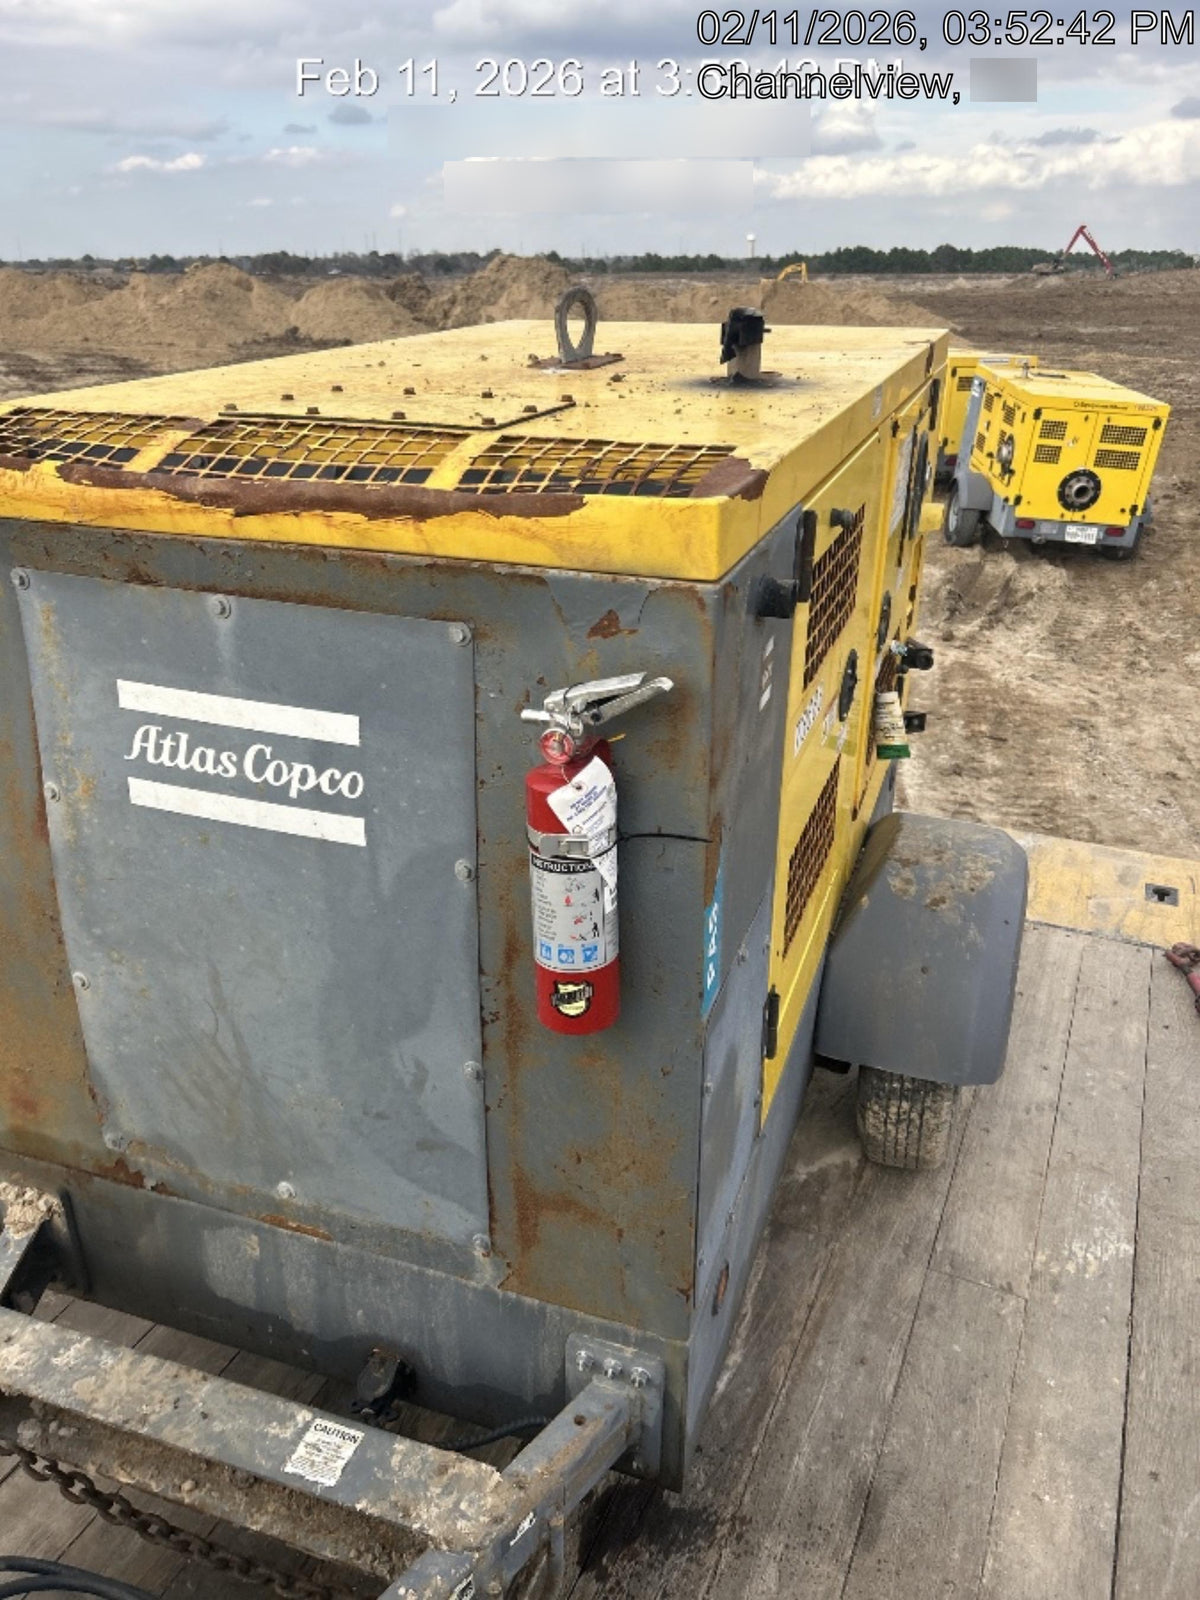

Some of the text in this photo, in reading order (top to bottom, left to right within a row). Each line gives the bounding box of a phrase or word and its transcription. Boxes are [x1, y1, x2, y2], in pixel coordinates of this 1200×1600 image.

[124, 724, 365, 800] Atlas Copco
[313, 1423, 360, 1445] CAUTION
